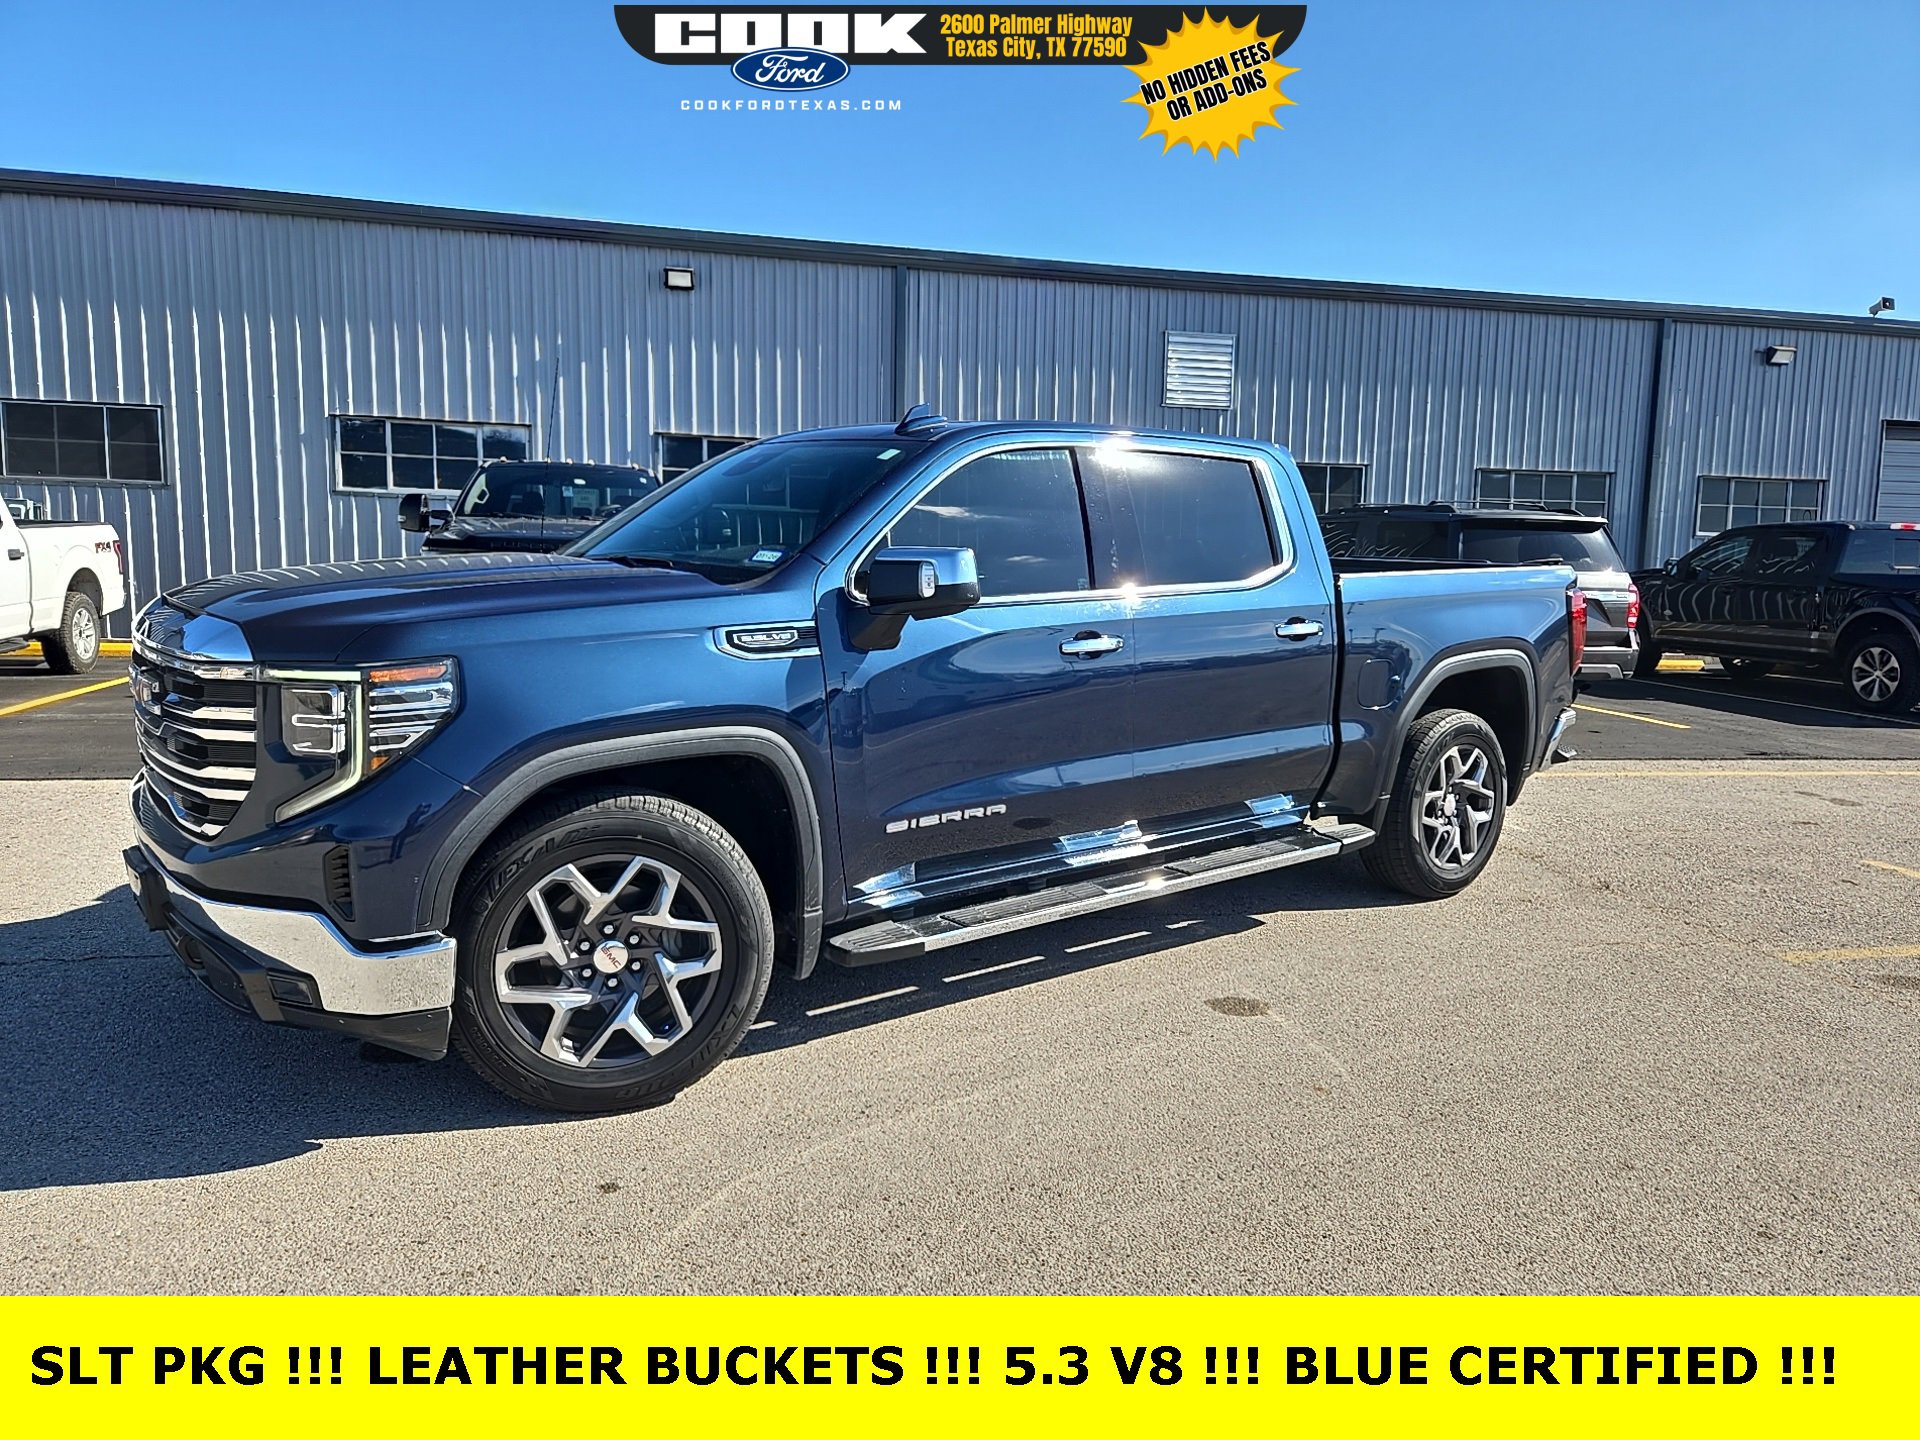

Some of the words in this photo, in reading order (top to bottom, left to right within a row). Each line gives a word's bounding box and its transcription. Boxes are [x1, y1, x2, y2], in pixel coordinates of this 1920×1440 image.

[95, 541, 111, 554] FX4
[885, 804, 1007, 834] SIERRA
[601, 945, 622, 969] GMC
